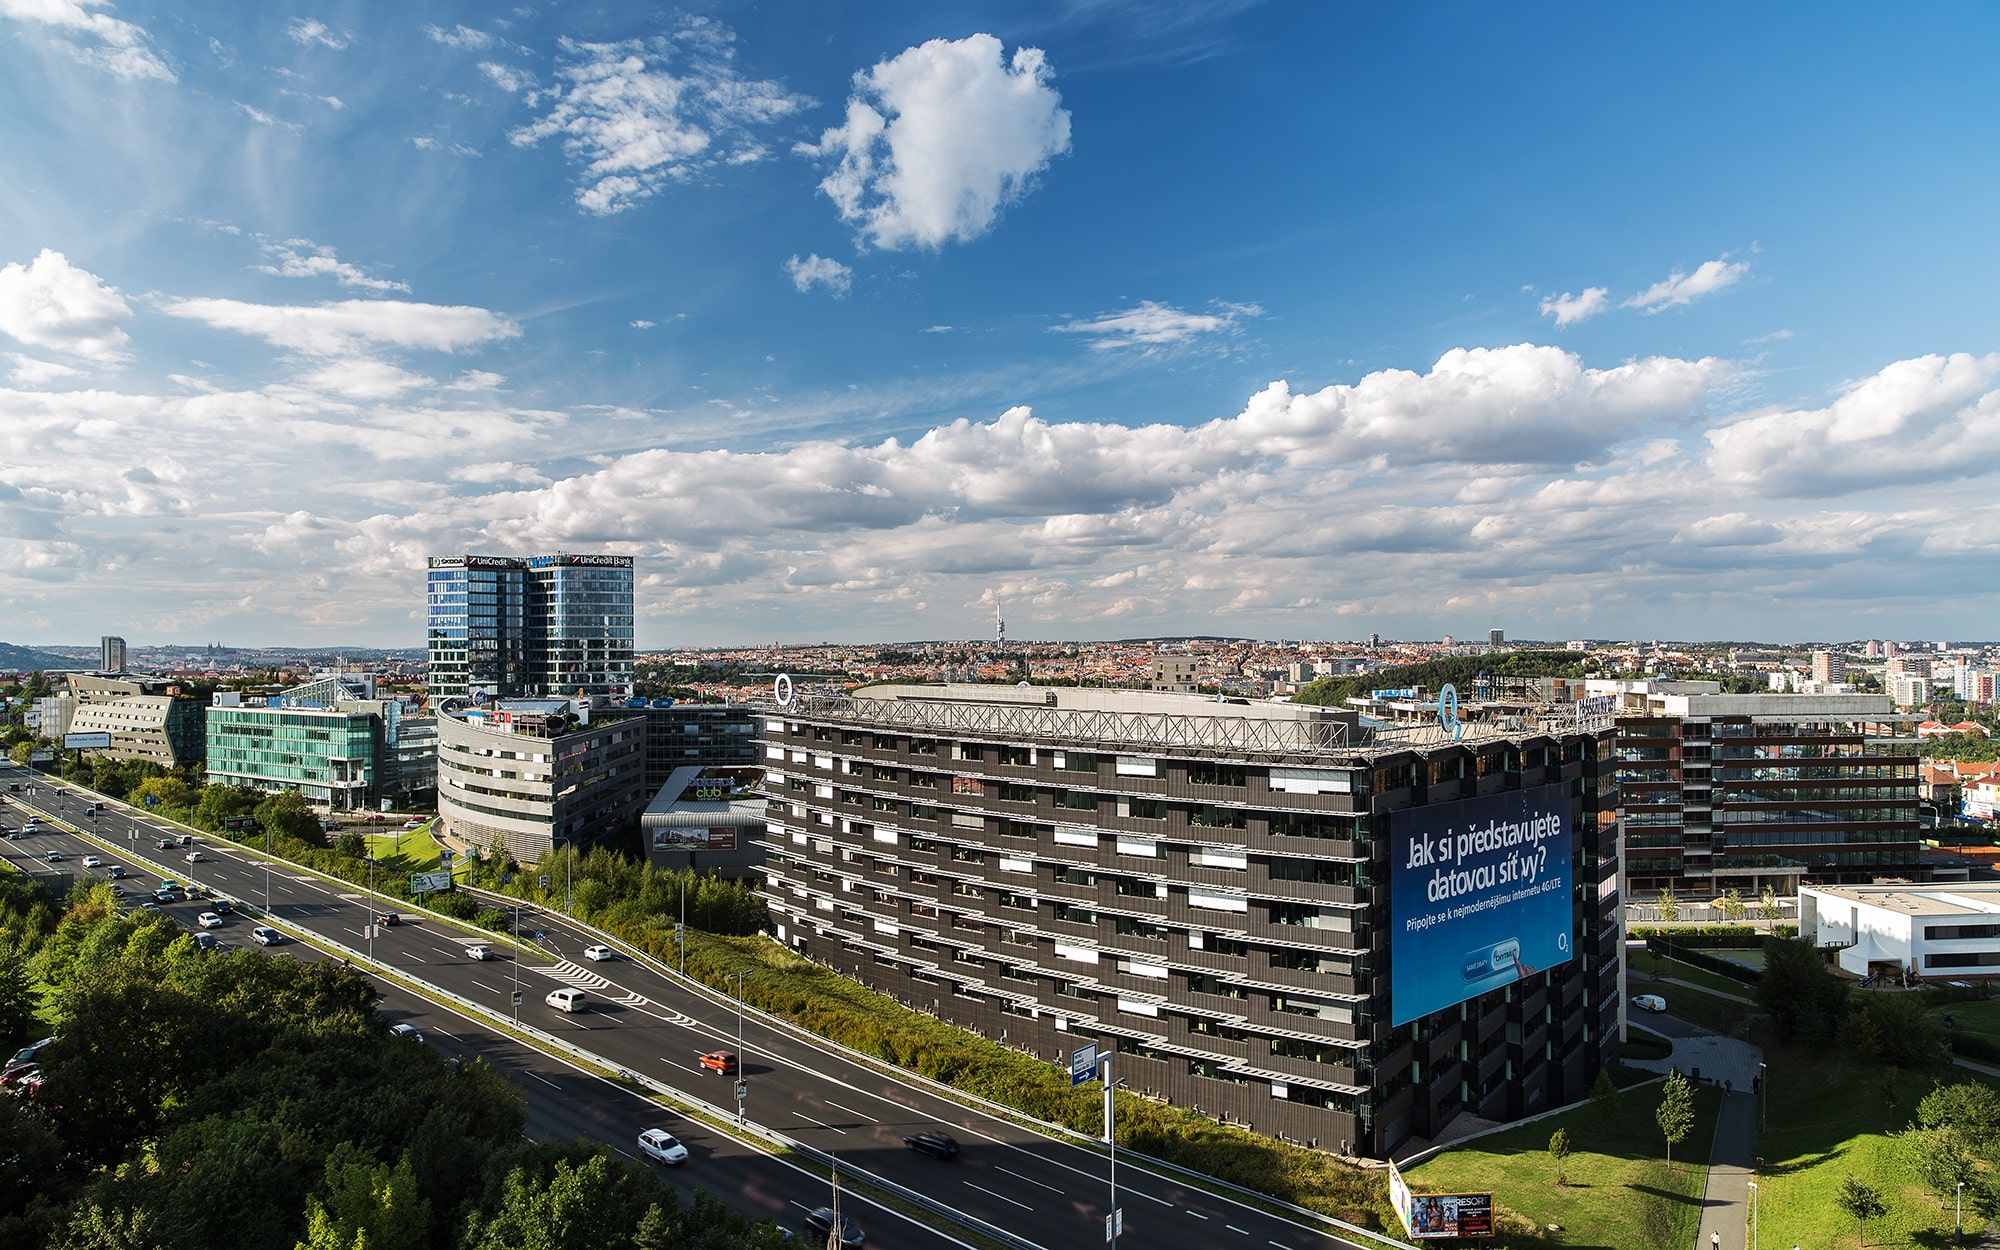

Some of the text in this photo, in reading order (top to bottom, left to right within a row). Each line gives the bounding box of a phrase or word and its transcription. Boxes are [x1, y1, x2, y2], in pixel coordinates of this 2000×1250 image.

[477, 557, 507, 566] UniCredit
[581, 556, 631, 565] UniCredit Bank
[696, 786, 721, 798] club
[1406, 811, 1561, 869] Jak si představujete
[1428, 845, 1547, 902] datovou síť vy?
[1406, 877, 1562, 932] Připojte se k nejmodernějšímu internetu 4G/LTE
[1456, 1196, 1488, 1206] RESORT
